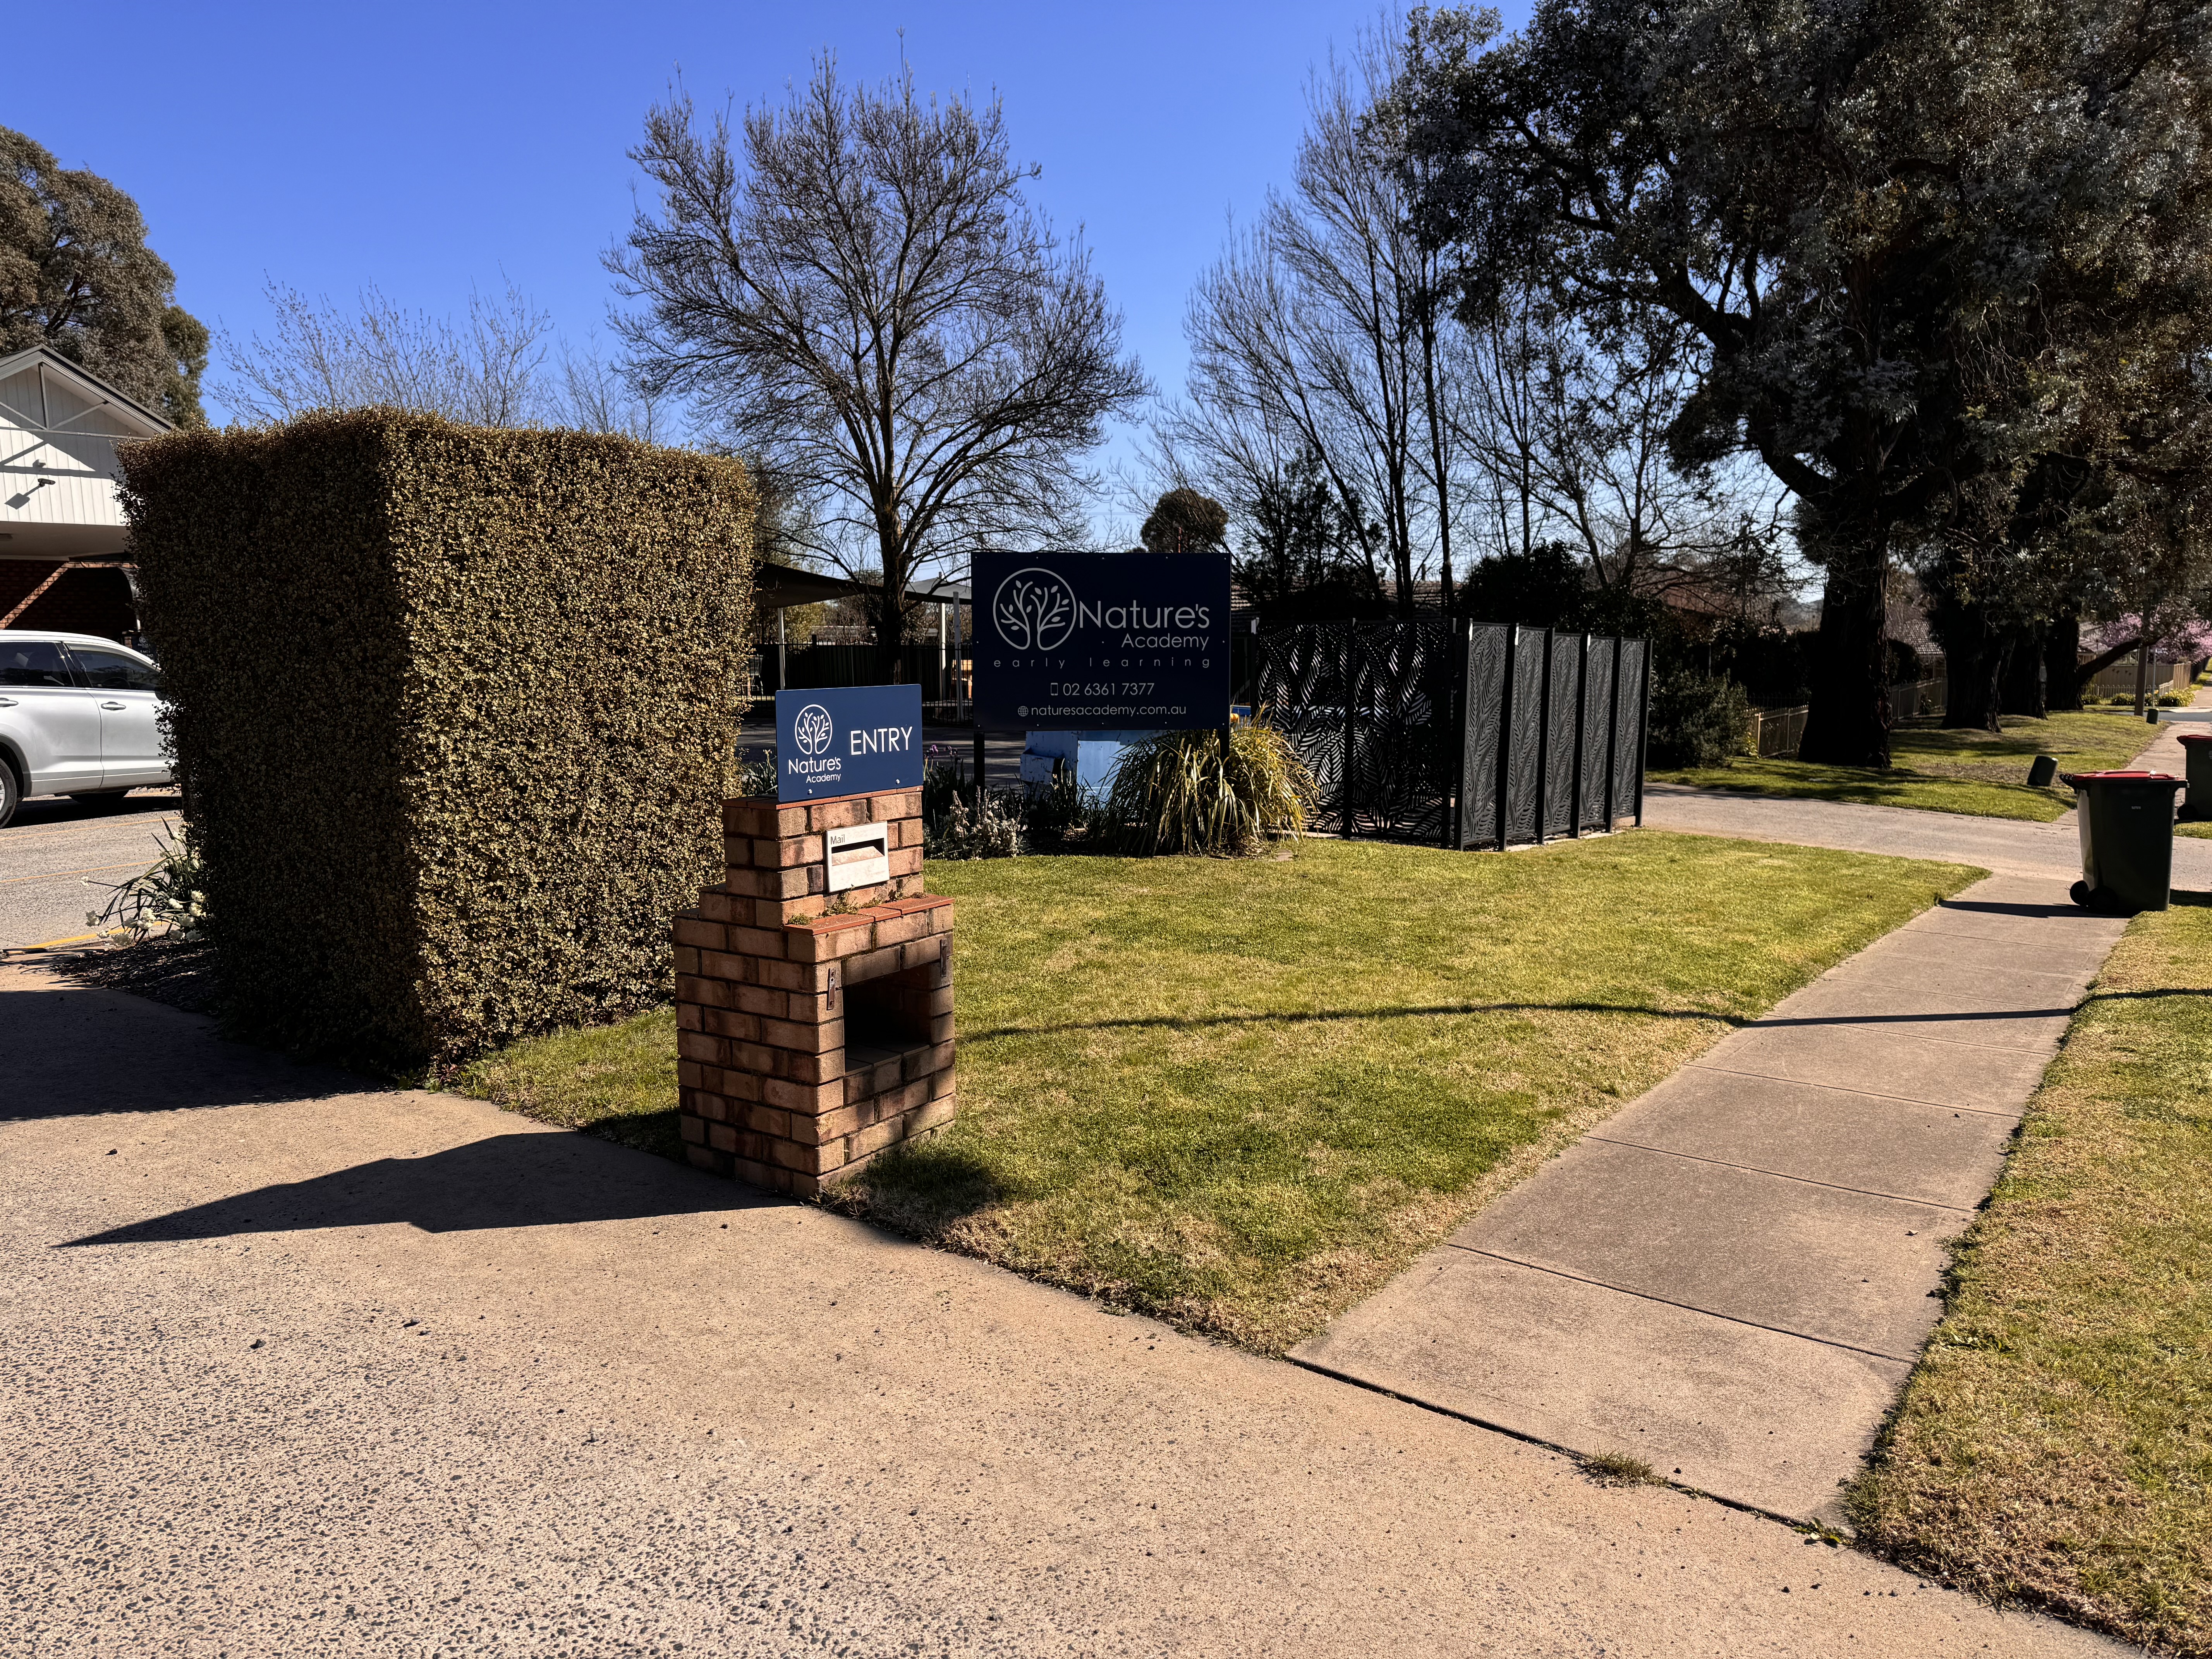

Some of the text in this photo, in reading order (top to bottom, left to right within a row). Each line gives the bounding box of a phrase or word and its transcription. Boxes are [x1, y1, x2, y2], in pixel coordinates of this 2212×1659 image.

[1080, 600, 1209, 629] Nature's
[1121, 633, 1209, 651] Academy
[993, 657, 1209, 669] early learning
[1063, 682, 1155, 696] 02 6361 7377
[1031, 704, 1186, 717] naturesacademy.com.au
[850, 726, 913, 755] ENTRY
[788, 757, 842, 775] Nature's
[806, 773, 842, 784] Academy
[830, 834, 845, 845] Mail
